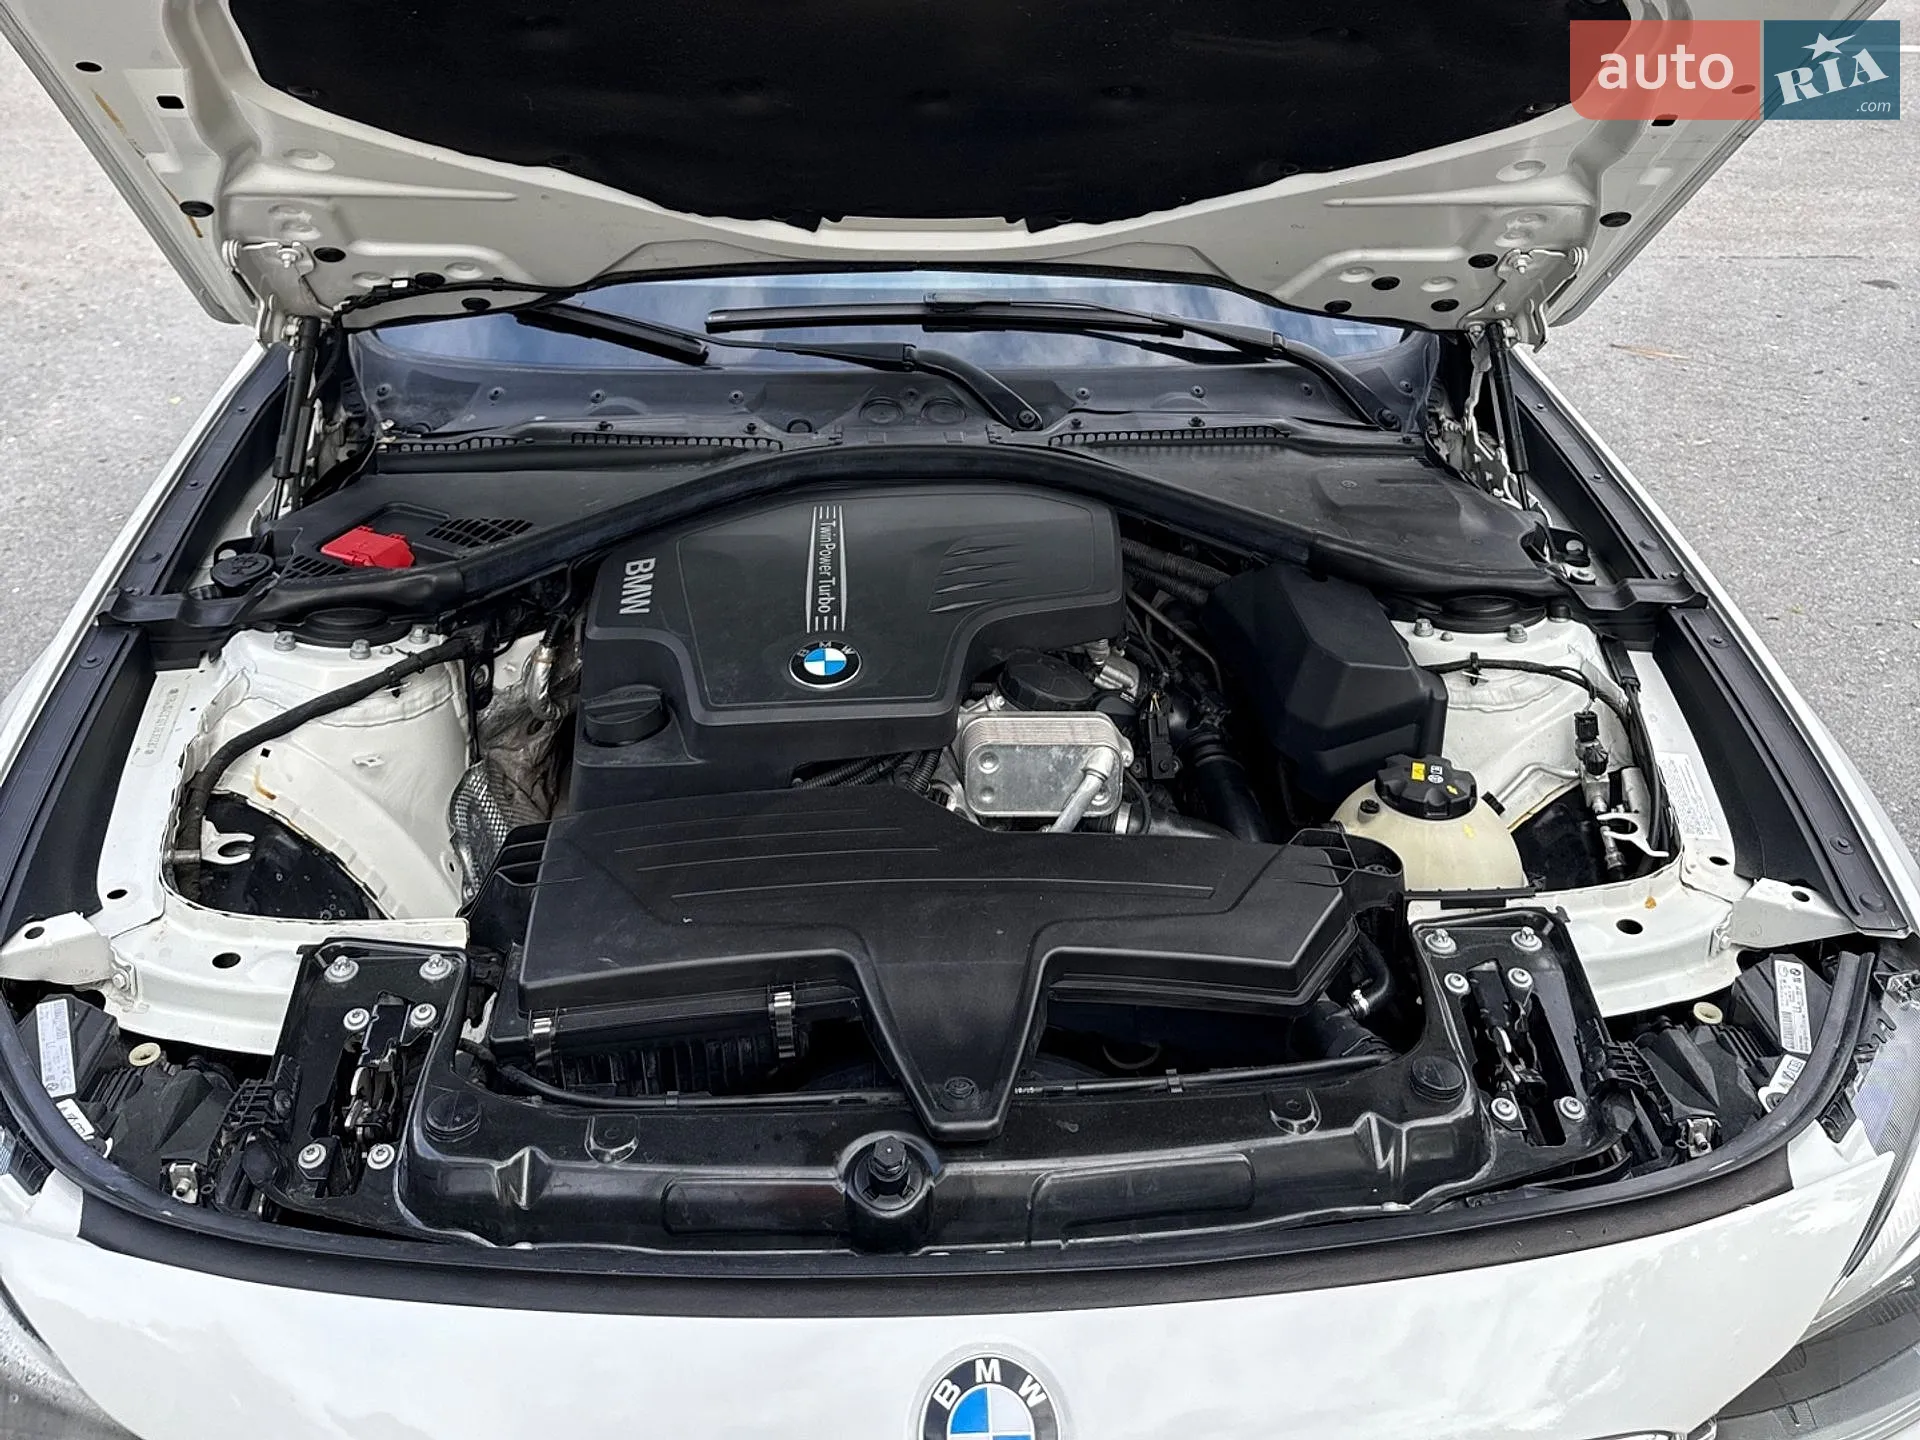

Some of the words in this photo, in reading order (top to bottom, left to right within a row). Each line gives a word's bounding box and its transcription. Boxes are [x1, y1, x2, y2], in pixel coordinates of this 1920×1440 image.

[819, 520, 836, 576] TwinPower
[619, 557, 656, 614] BMW
[817, 577, 836, 614] Turbo
[797, 640, 857, 658] BMW
[932, 1357, 1048, 1411] BMW
